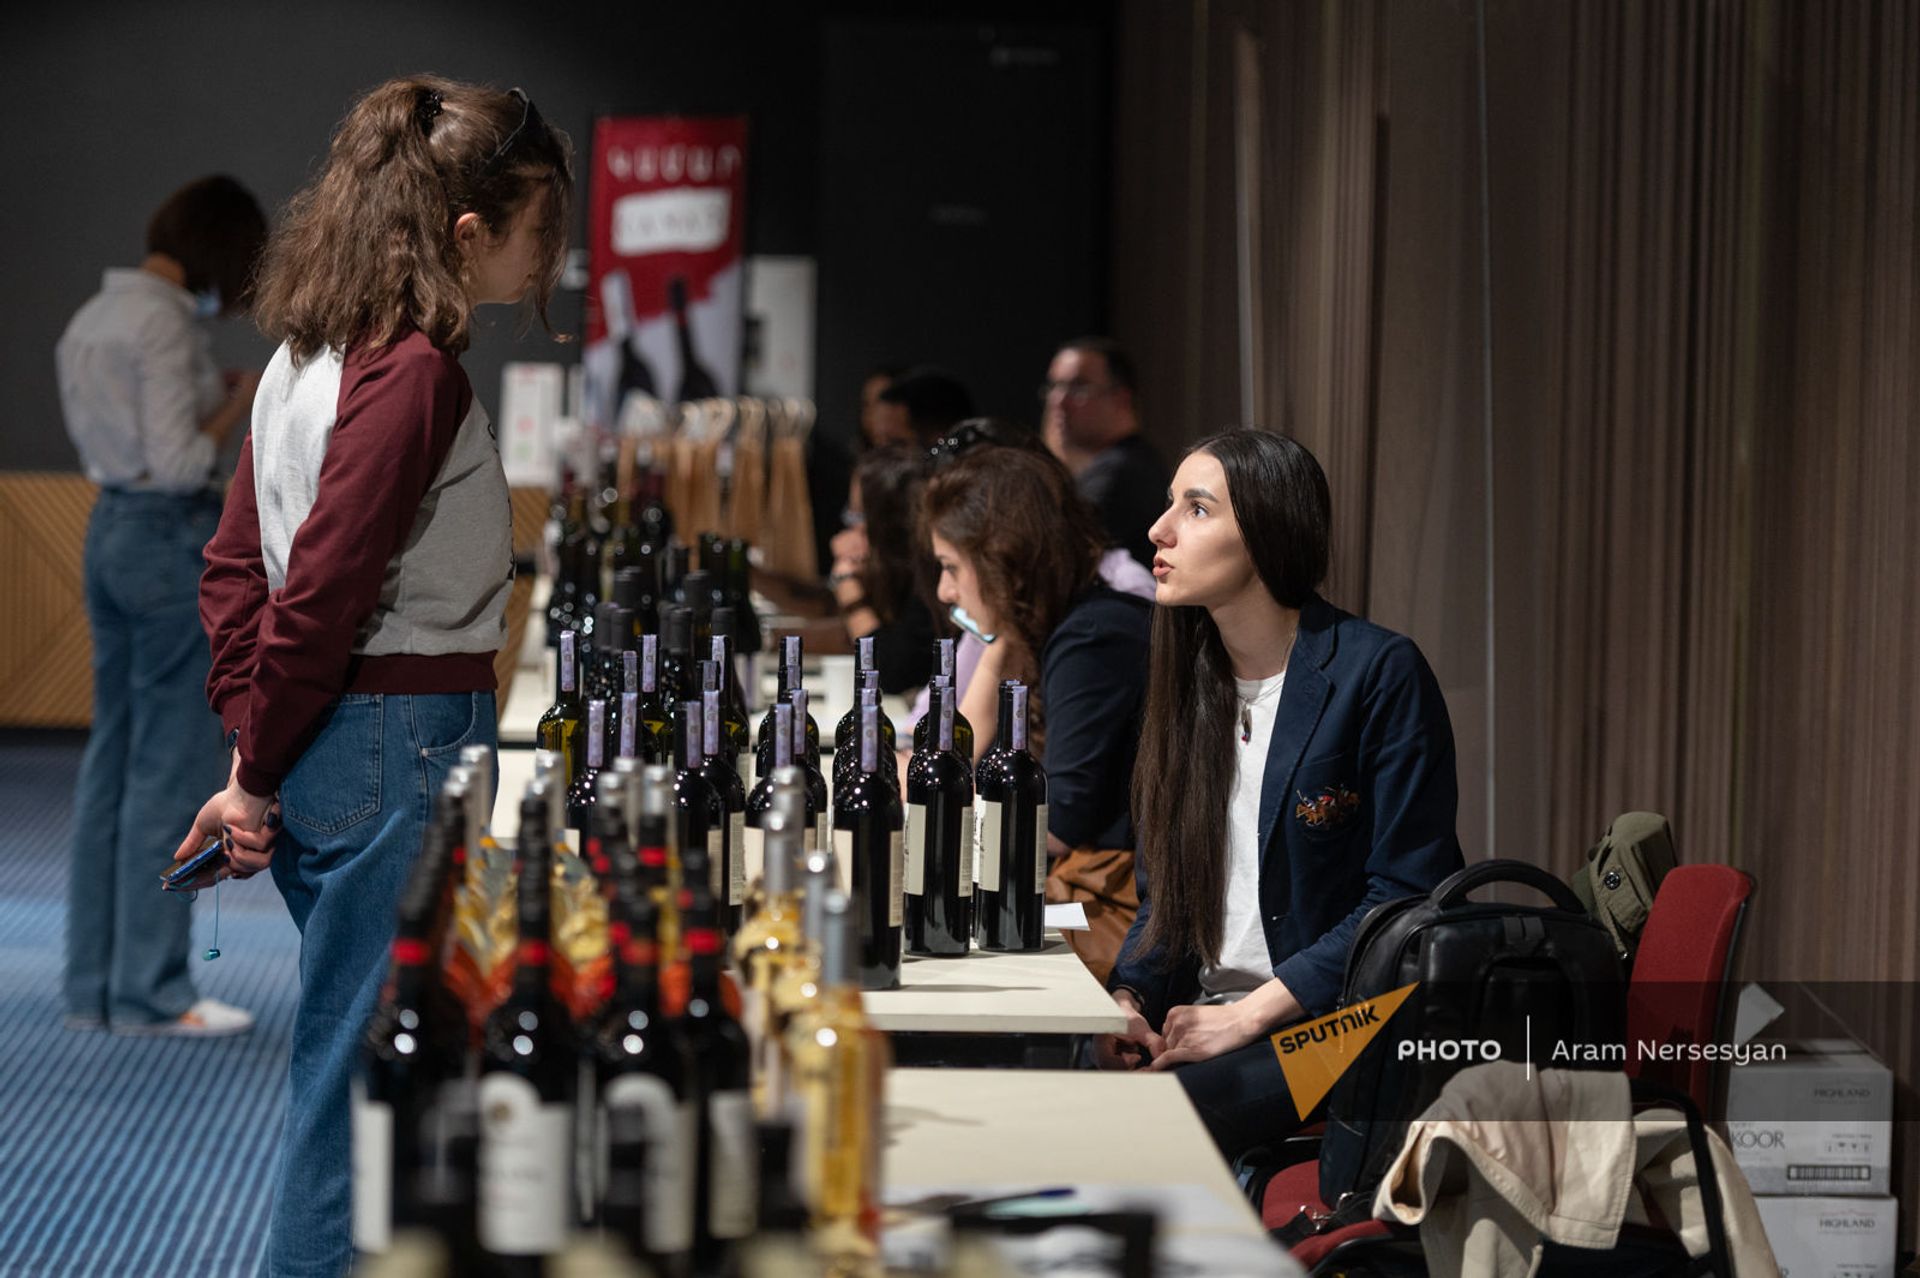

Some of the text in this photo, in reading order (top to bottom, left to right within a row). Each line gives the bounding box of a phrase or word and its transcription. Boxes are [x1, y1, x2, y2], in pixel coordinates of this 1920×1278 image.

[1814, 1088, 1871, 1098] HIGHLAND
[1731, 1129, 1786, 1149] KOOR
[1819, 1218, 1875, 1228] HIGHLAND
